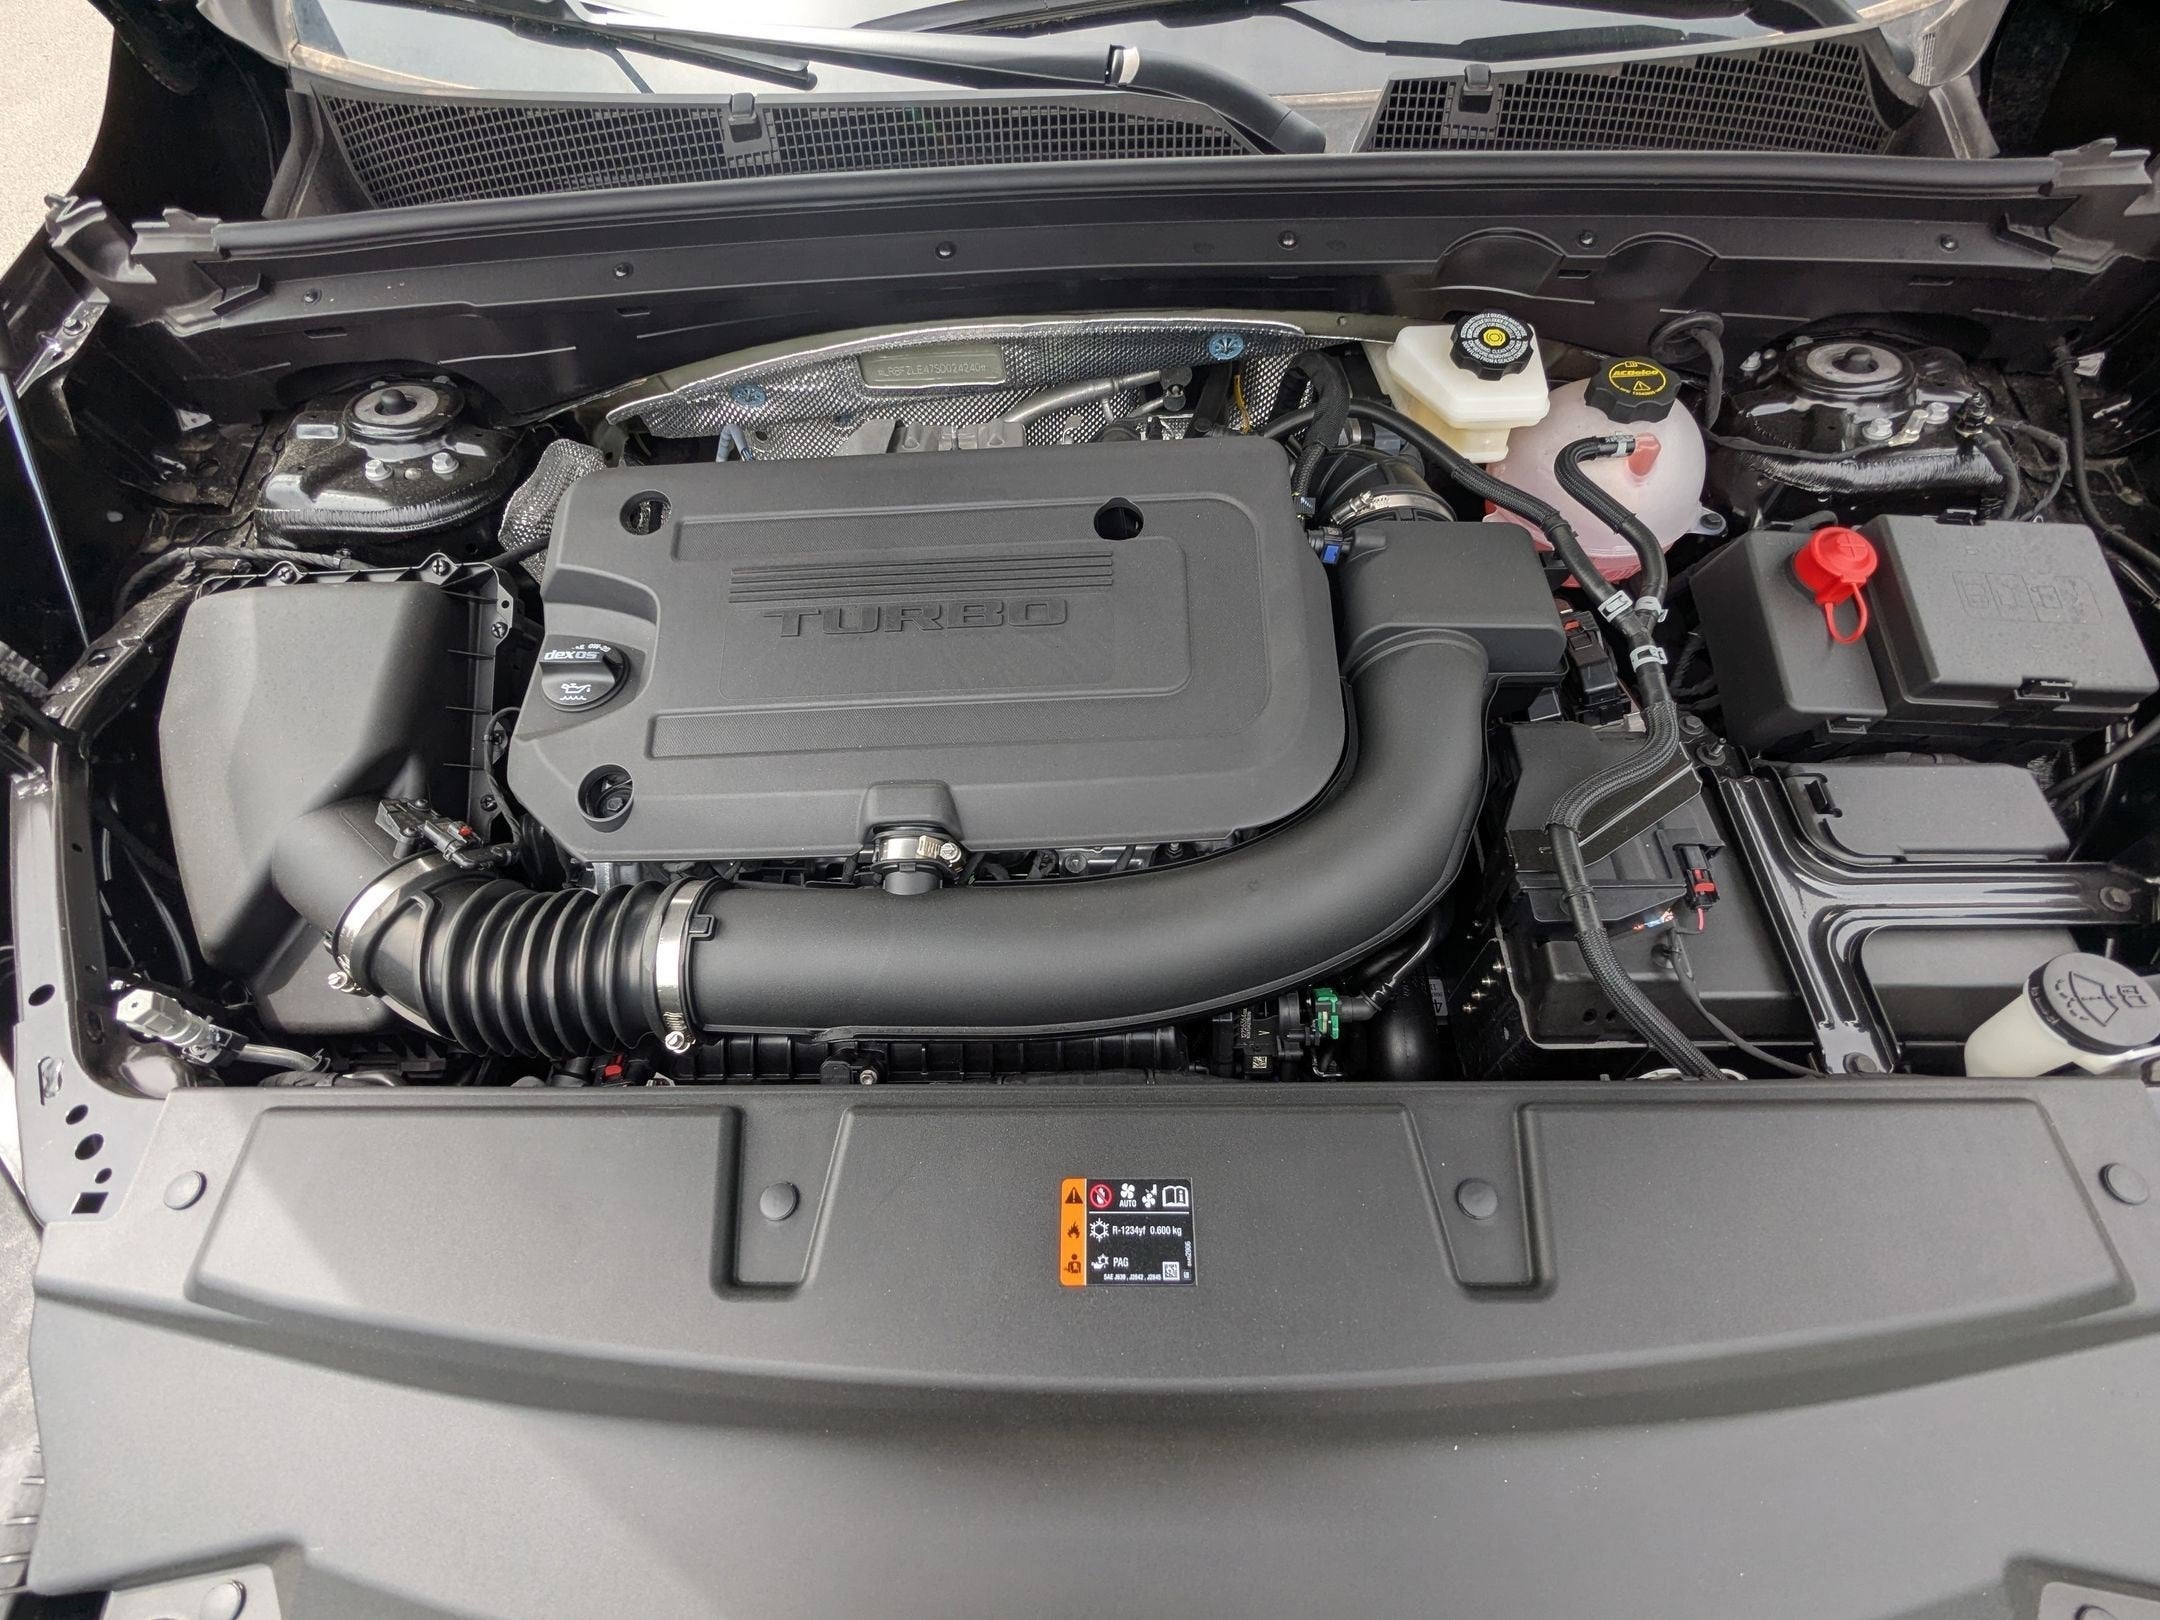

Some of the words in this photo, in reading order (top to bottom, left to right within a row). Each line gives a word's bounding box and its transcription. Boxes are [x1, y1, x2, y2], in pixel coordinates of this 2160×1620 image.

[1611, 370, 1660, 378] ACDelco
[763, 600, 1068, 638] TURBO
[544, 649, 600, 661] dexos
[1119, 1199, 1137, 1208] AUTO
[1112, 1225, 1146, 1237] R-1234yf
[1150, 1225, 1171, 1235] 0.600
[1172, 1225, 1182, 1237] kg
[1113, 1257, 1129, 1267] PAG
